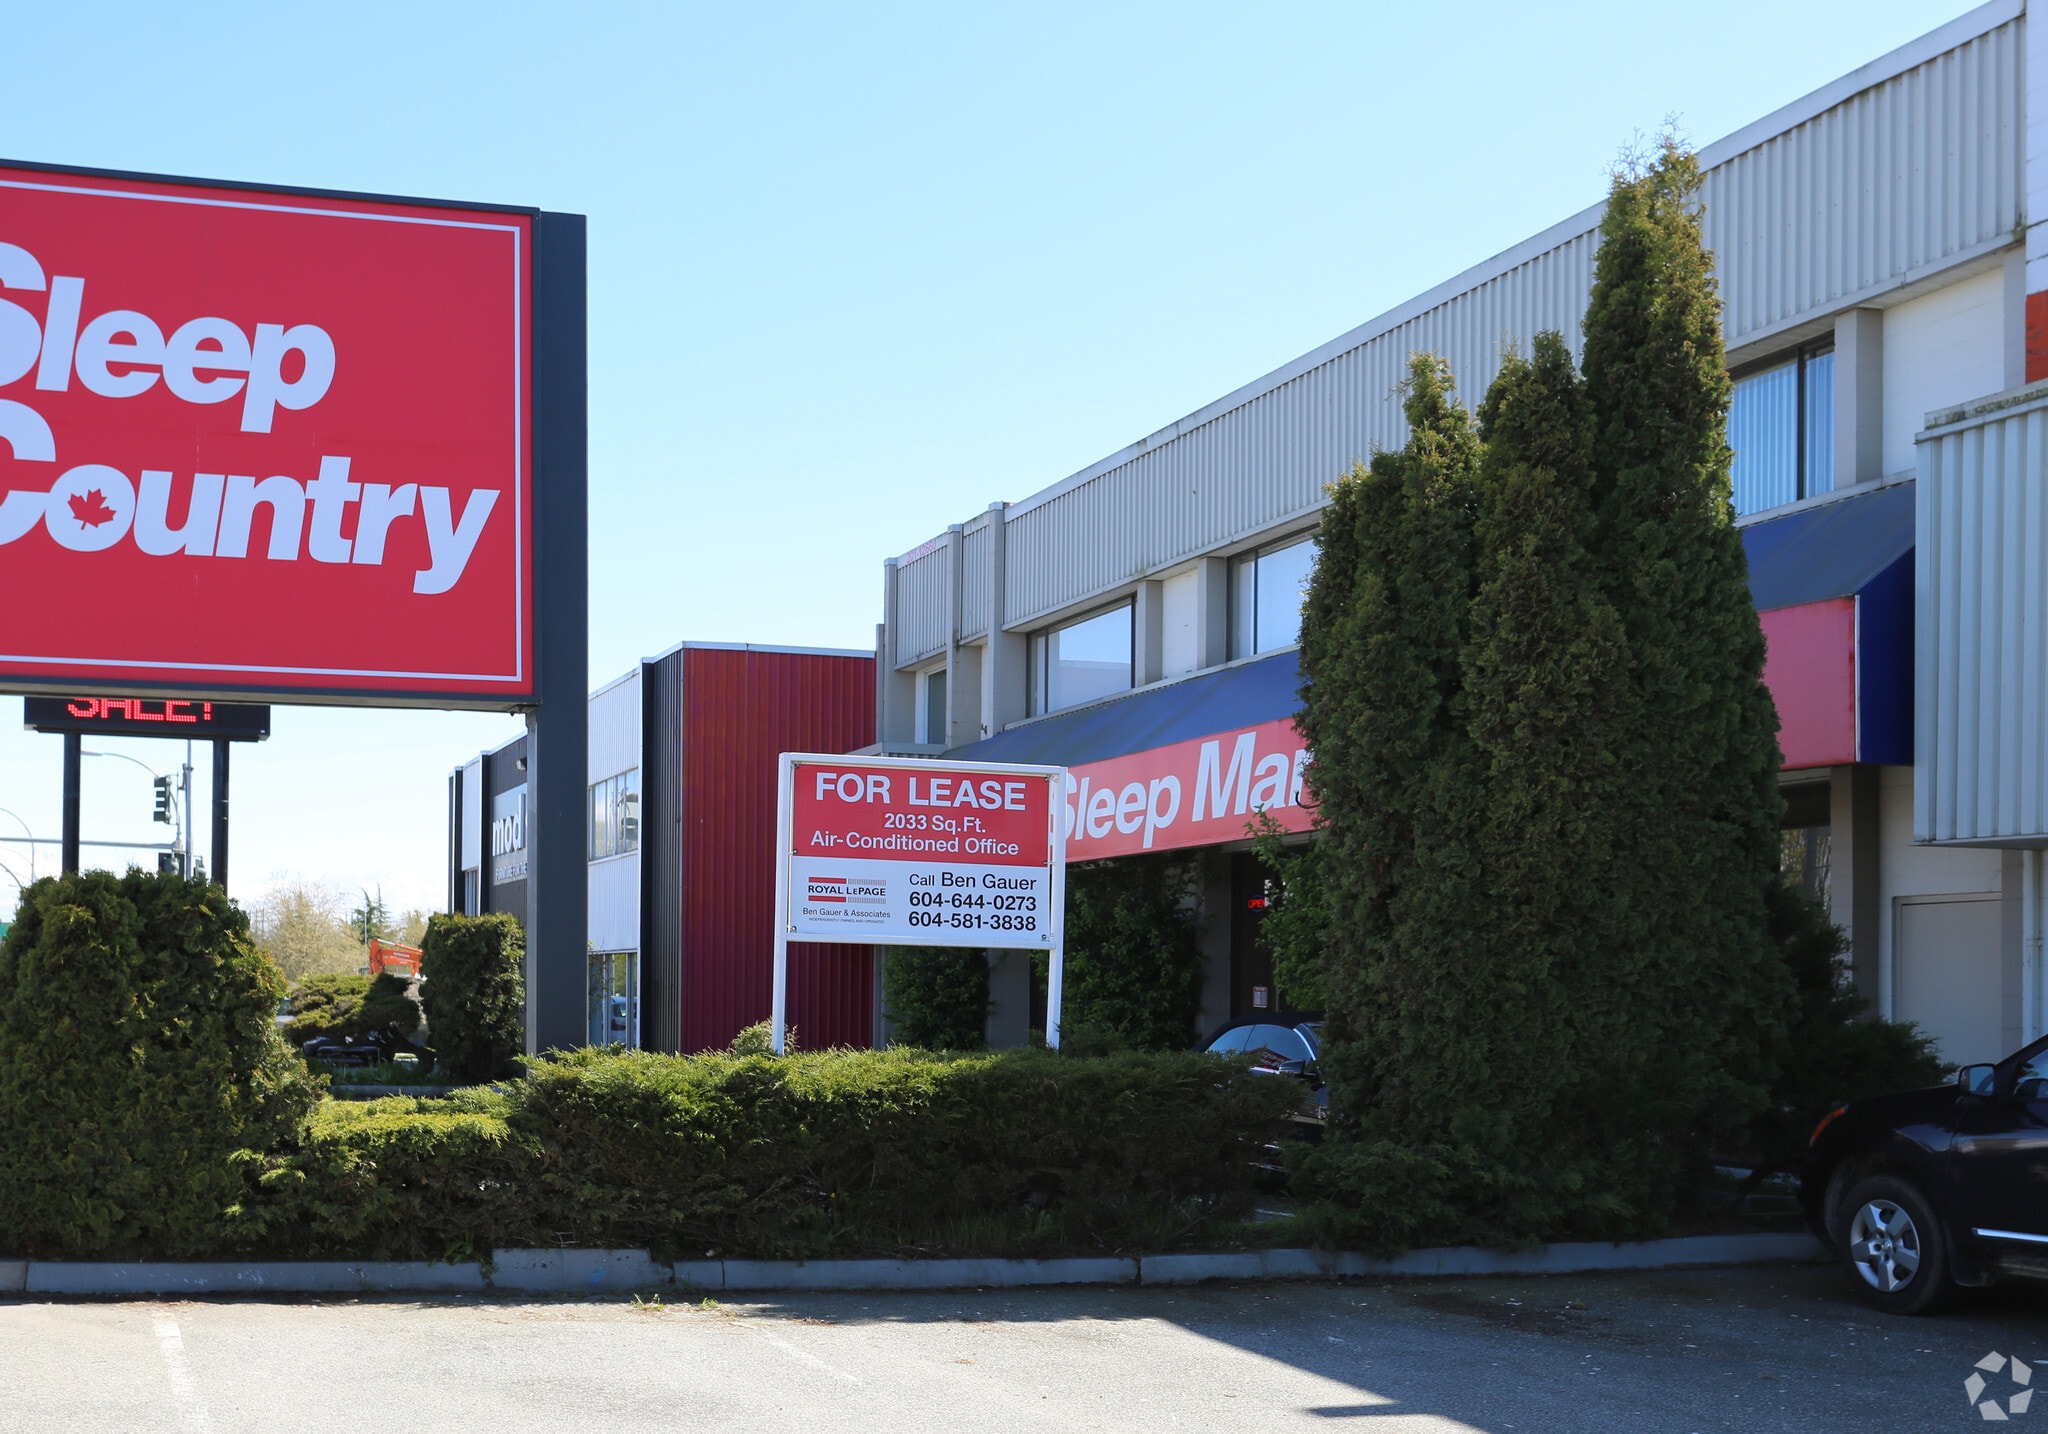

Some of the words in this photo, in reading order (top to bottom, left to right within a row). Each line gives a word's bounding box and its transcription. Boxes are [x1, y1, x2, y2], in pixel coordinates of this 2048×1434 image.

[816, 772, 891, 804] FOR
[909, 777, 1026, 811] LEASE
[884, 813, 928, 830] 2033
[931, 815, 986, 835] Sq.Ft.
[965, 837, 1019, 856] Office
[808, 885, 844, 895] ROYAL
[909, 874, 935, 886] Call
[941, 872, 976, 888] Ben
[982, 873, 1037, 890] Gauer
[909, 891, 1037, 911] 604-644-0273
[802, 907, 818, 915] Ben
[819, 908, 842, 917] Gauer
[843, 909, 849, 917] &
[850, 909, 891, 918] Associates
[908, 911, 1037, 931] 604-581-3838
